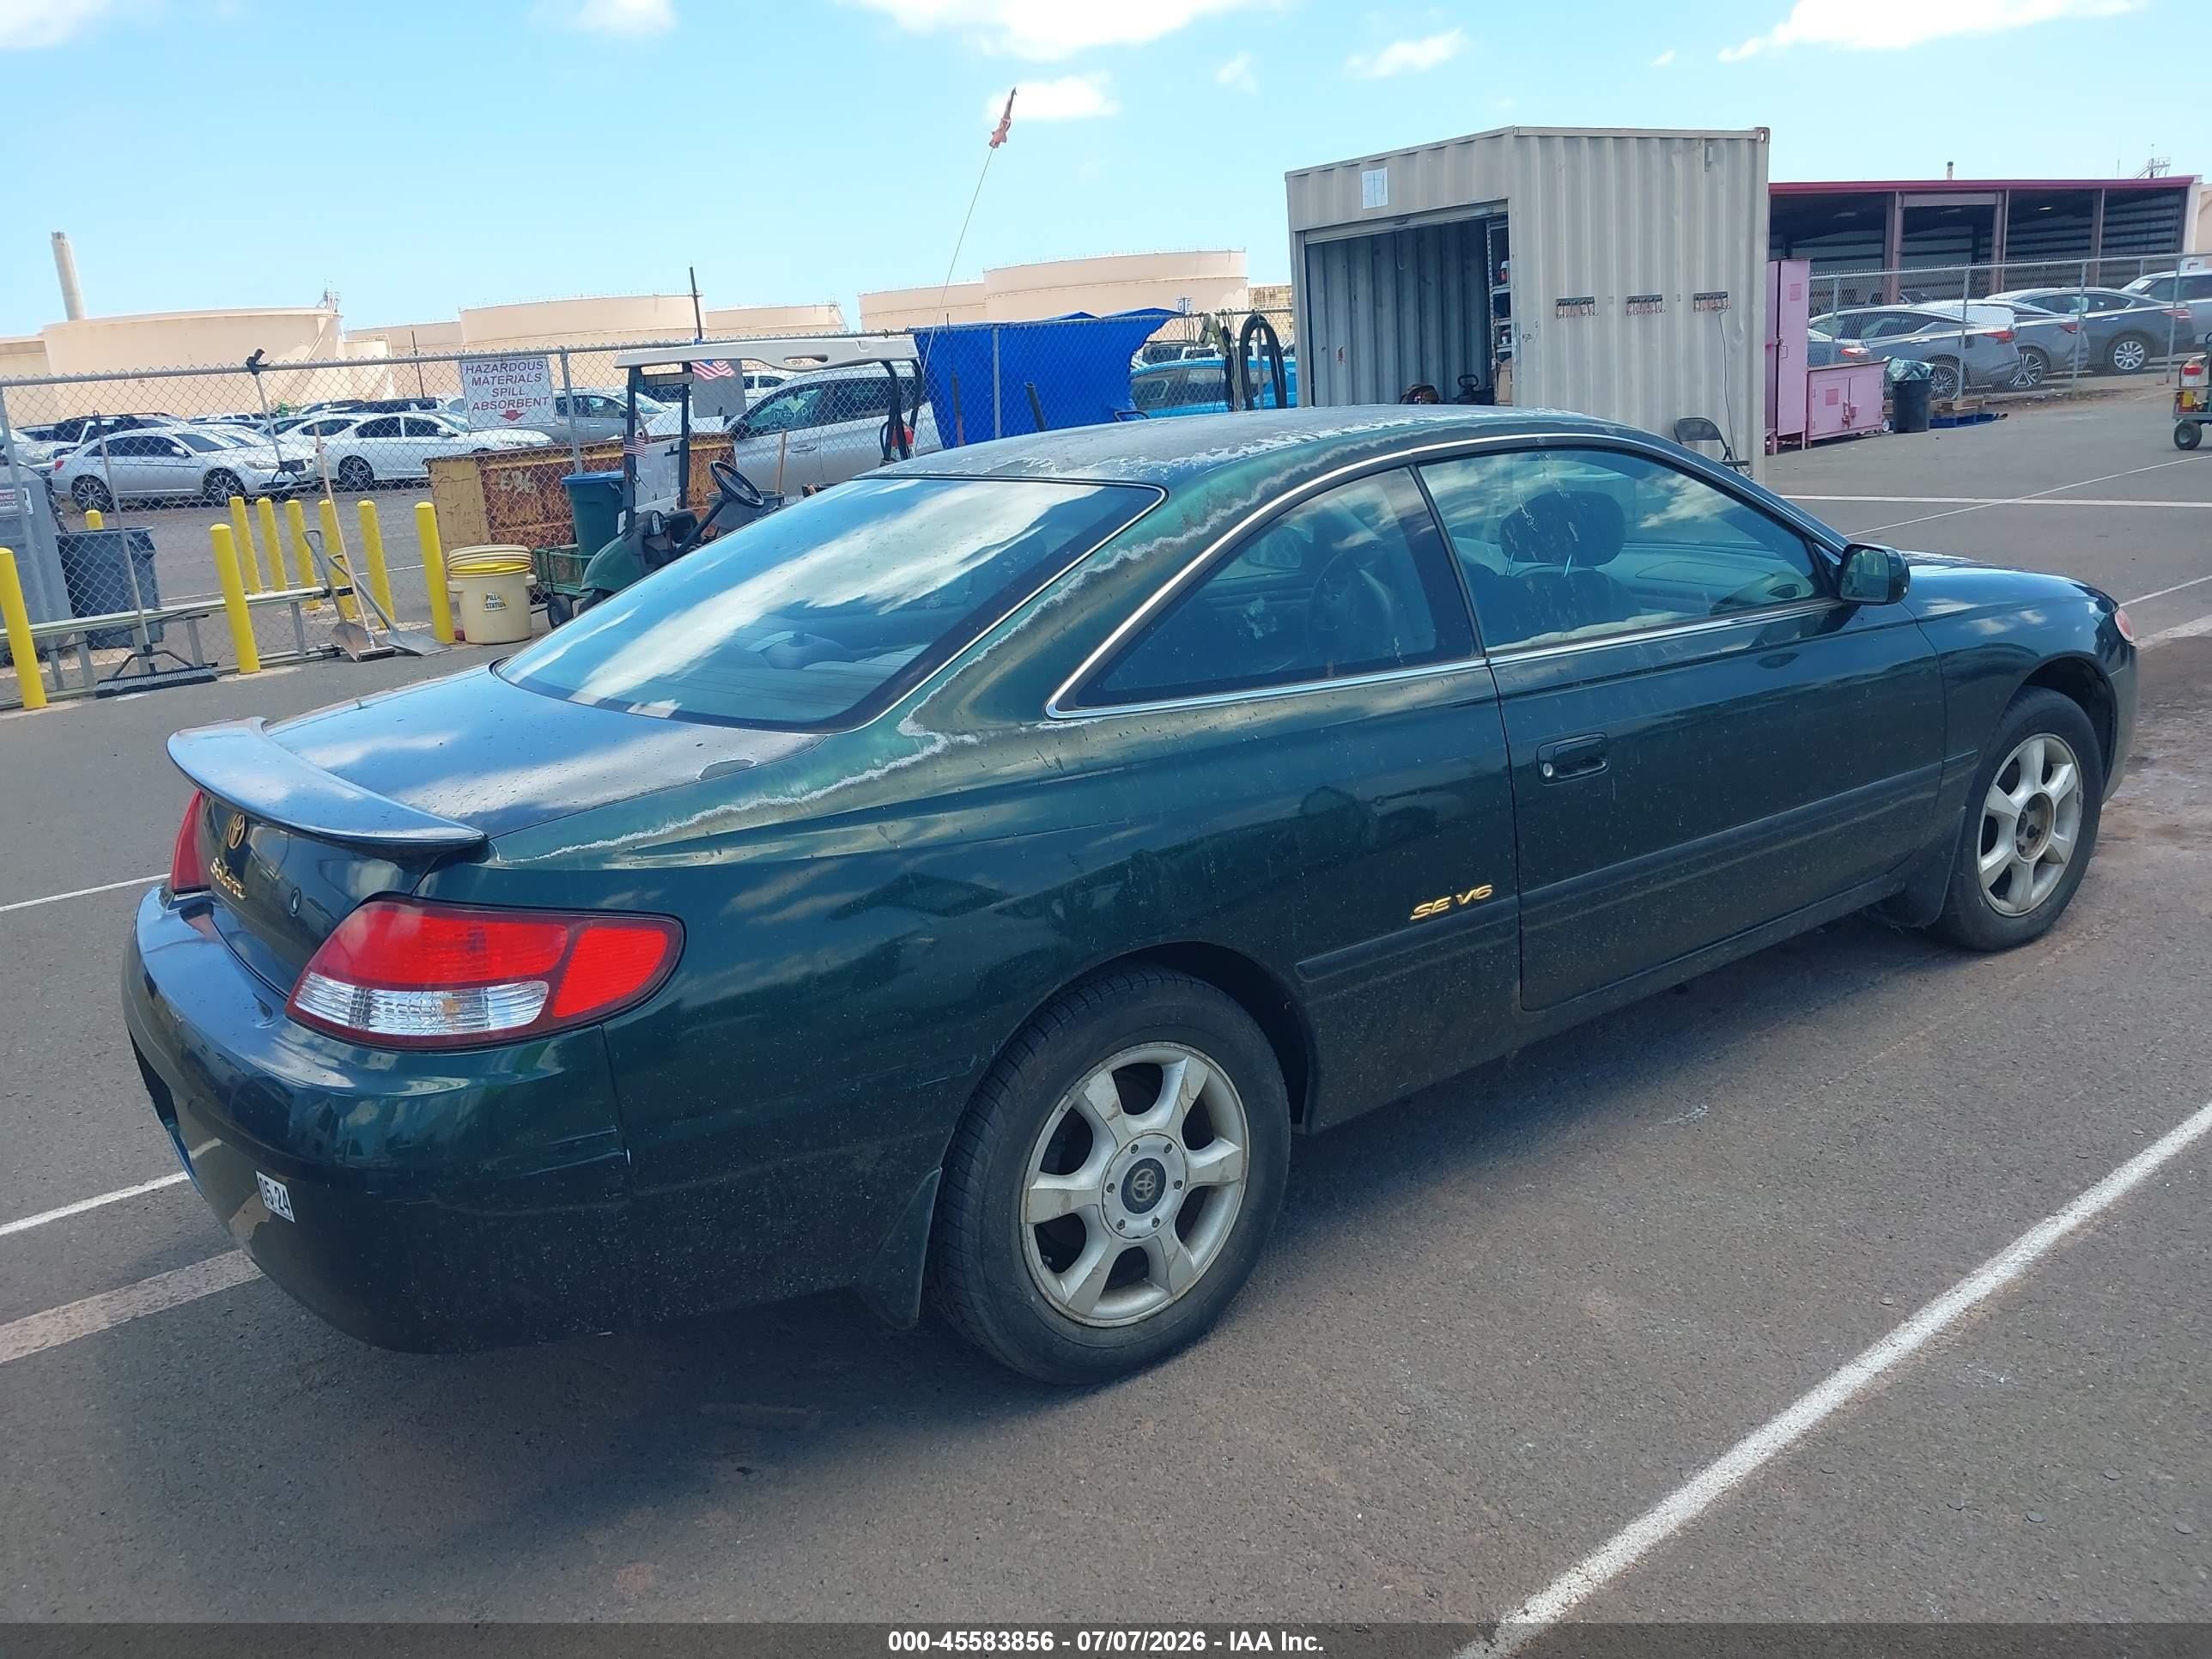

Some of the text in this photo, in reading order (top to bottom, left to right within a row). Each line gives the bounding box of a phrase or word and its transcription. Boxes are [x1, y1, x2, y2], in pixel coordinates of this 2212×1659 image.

[465, 361, 544, 374] HAZARDOUS
[471, 373, 543, 386] MATERIALS
[492, 387, 526, 398] SPILL
[472, 397, 550, 411] ABSORBENT
[1410, 884, 1492, 921] SE V6
